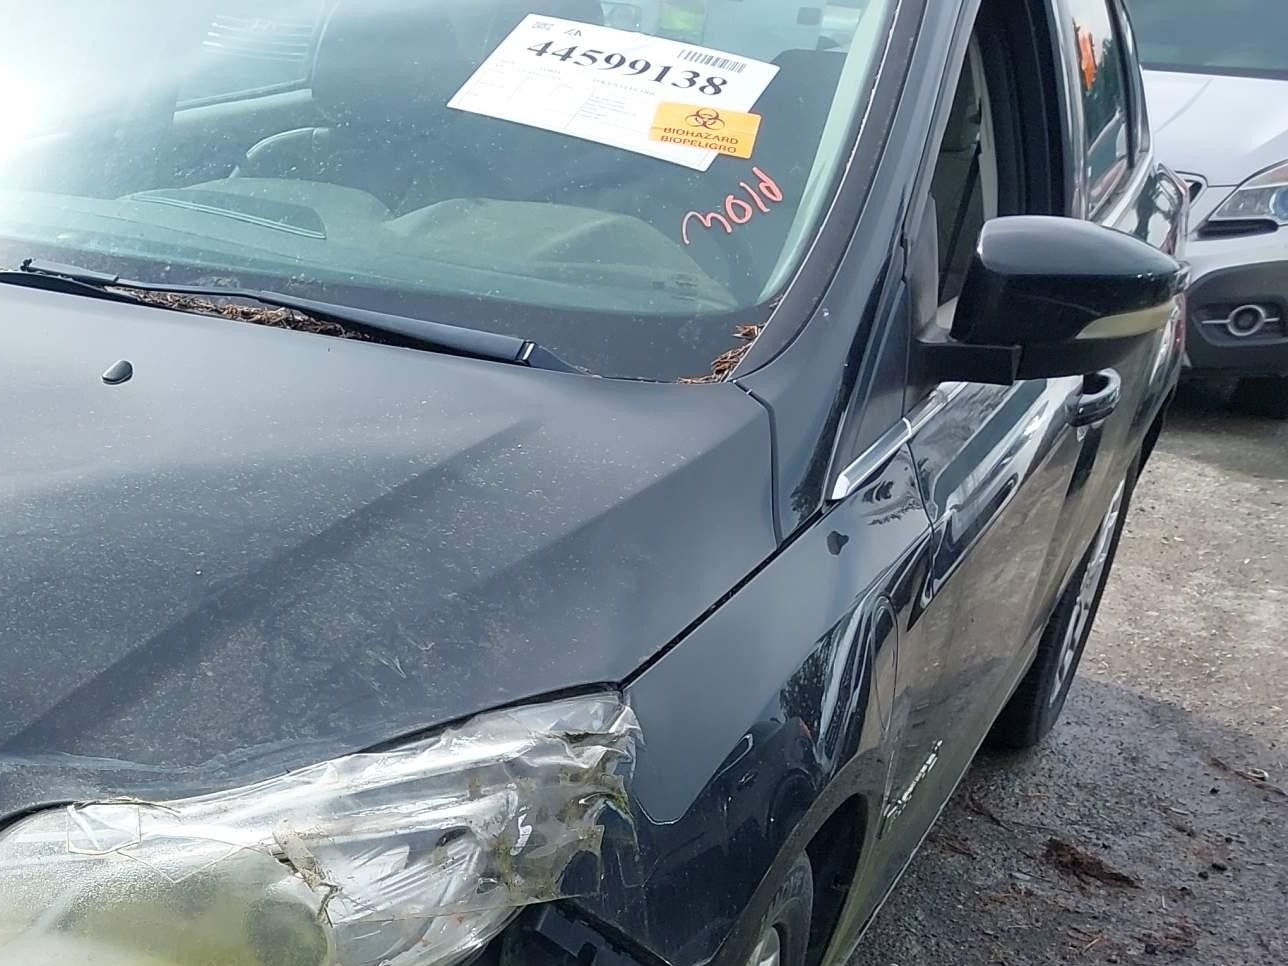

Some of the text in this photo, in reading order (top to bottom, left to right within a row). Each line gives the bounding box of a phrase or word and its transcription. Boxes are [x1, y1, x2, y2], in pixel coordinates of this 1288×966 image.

[526, 40, 728, 96] 44599138
[660, 135, 737, 153] BIOPELIGRO
[663, 127, 739, 145] BIOHAZARD
